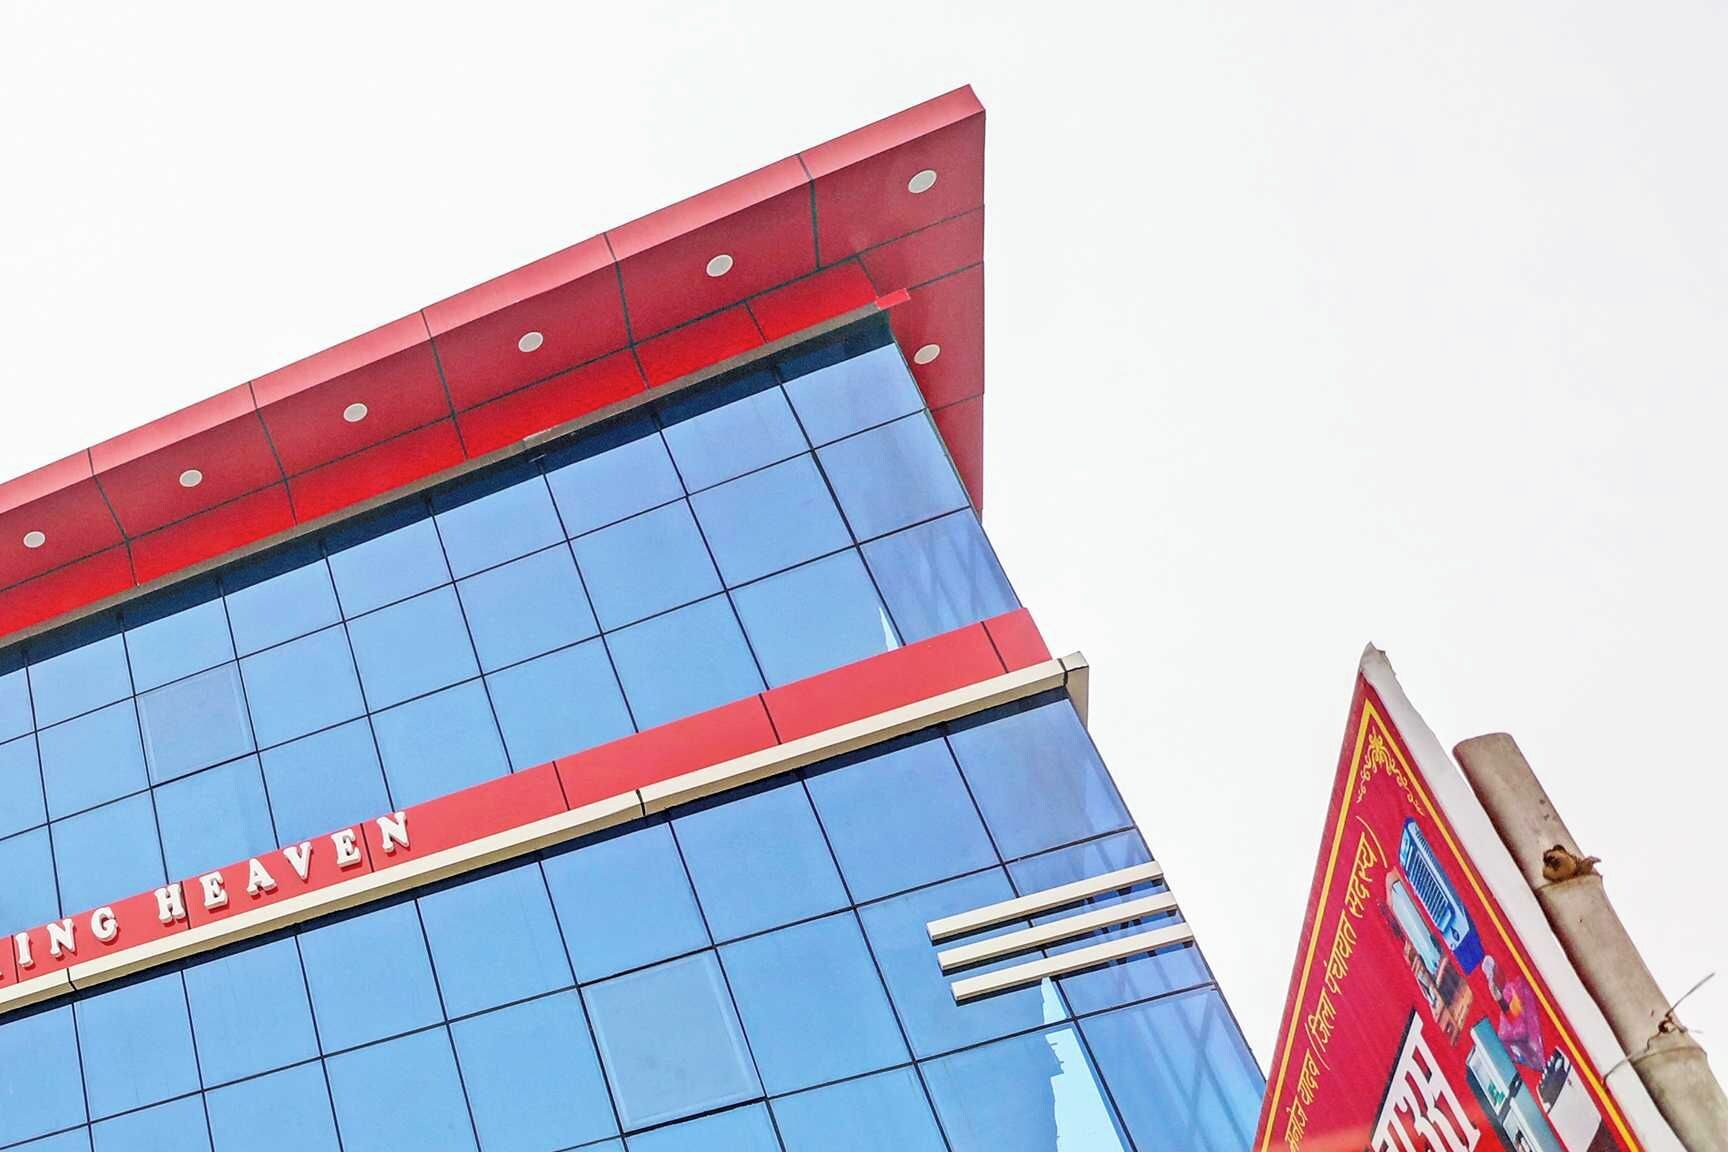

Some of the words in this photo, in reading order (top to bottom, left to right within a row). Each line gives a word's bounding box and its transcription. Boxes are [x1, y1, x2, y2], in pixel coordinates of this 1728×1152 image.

[154, 811, 410, 924] HEAVEN
[1345, 816, 1387, 917] सदस्य)
[1324, 910, 1356, 993] पंचायत
[1305, 988, 1335, 1070] (जिला
[1298, 1050, 1319, 1104] यादव
